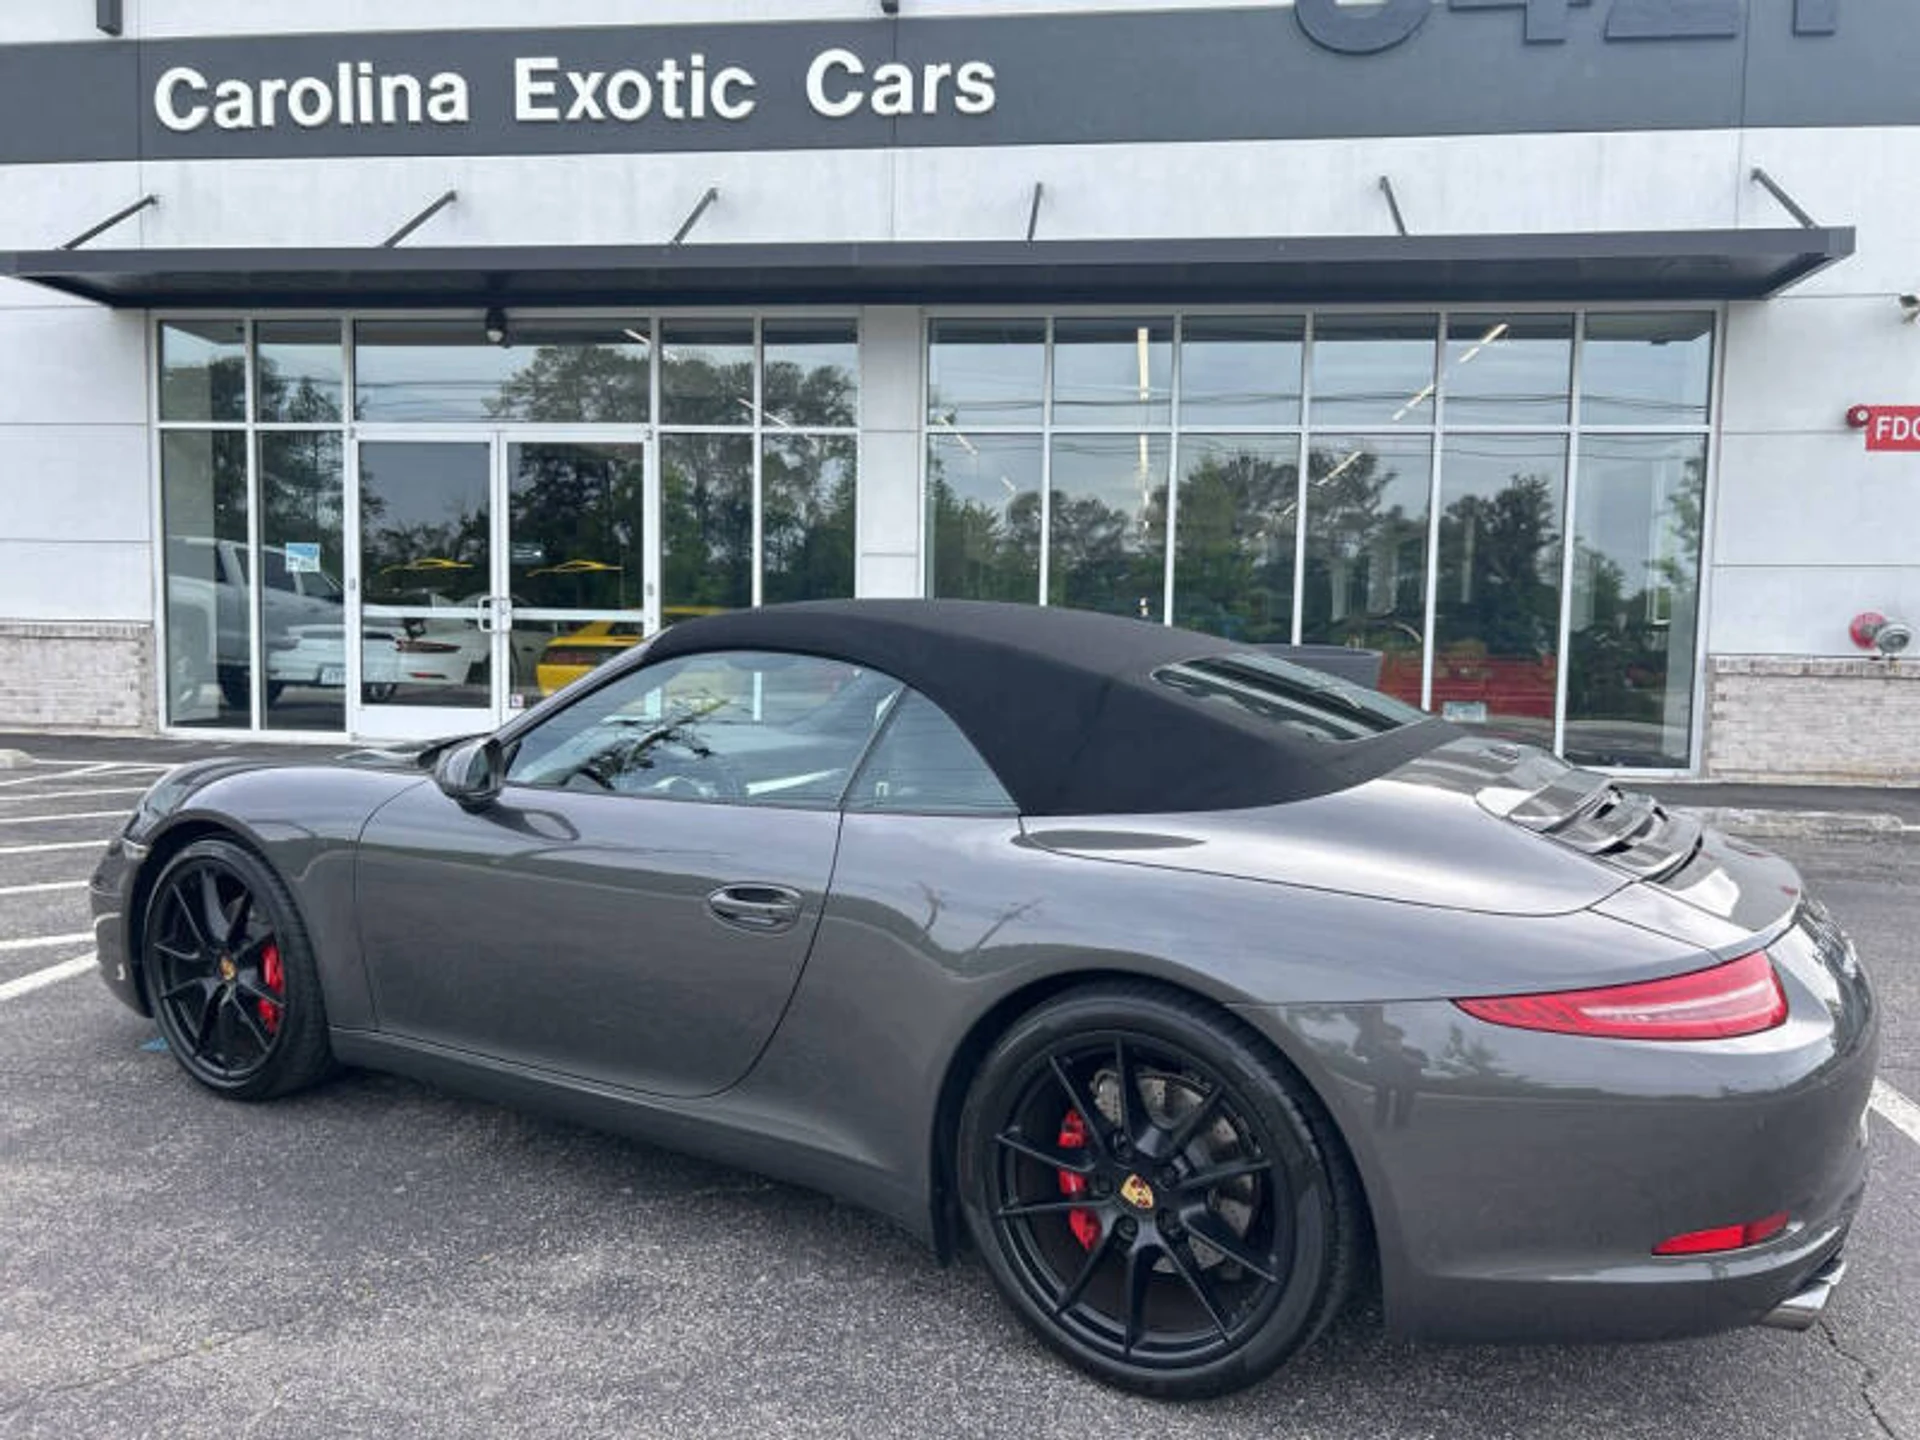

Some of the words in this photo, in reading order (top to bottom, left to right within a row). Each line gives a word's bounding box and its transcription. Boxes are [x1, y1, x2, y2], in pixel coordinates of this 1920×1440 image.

[154, 61, 470, 131] Carolina
[514, 53, 756, 121] Exotic
[806, 49, 997, 117] Cars
